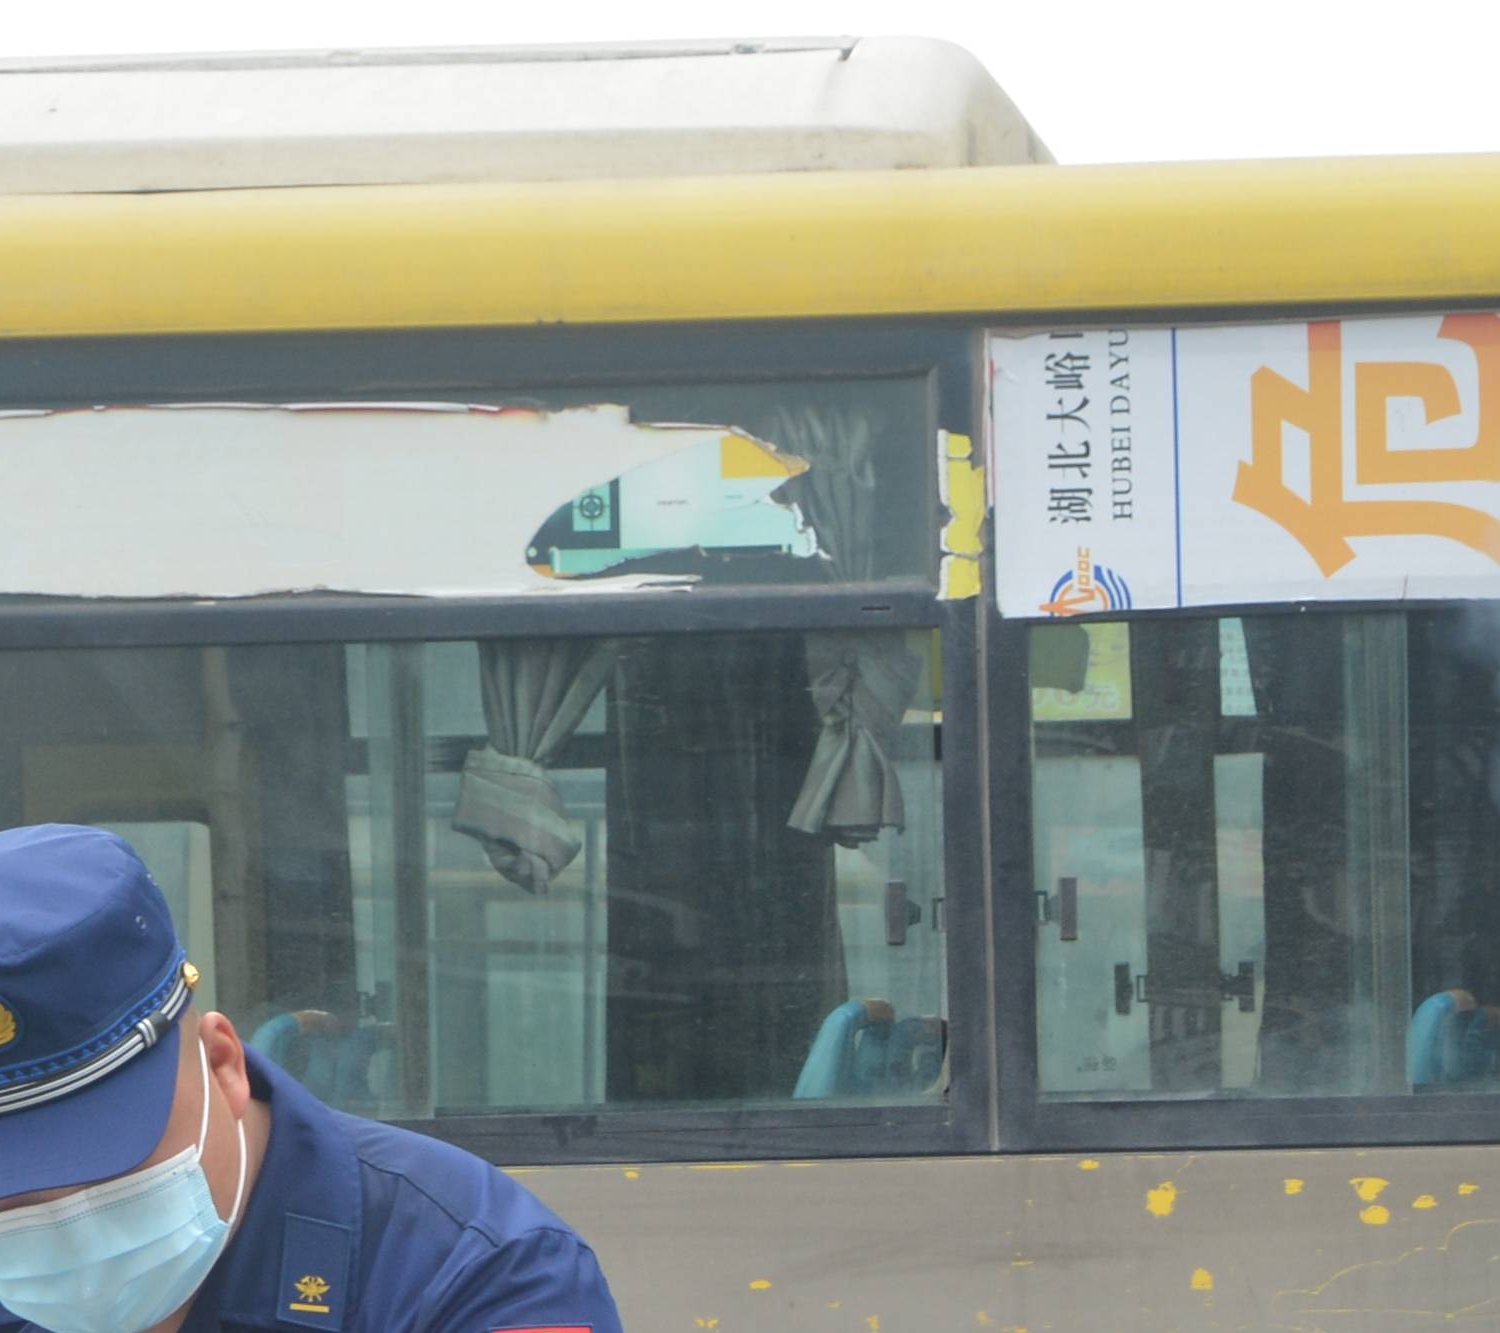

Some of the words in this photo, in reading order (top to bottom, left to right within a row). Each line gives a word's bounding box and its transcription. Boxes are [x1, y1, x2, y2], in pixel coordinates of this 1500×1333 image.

[1044, 331, 1094, 525] 湖北大峪
[1110, 426, 1134, 521] HUBEI
